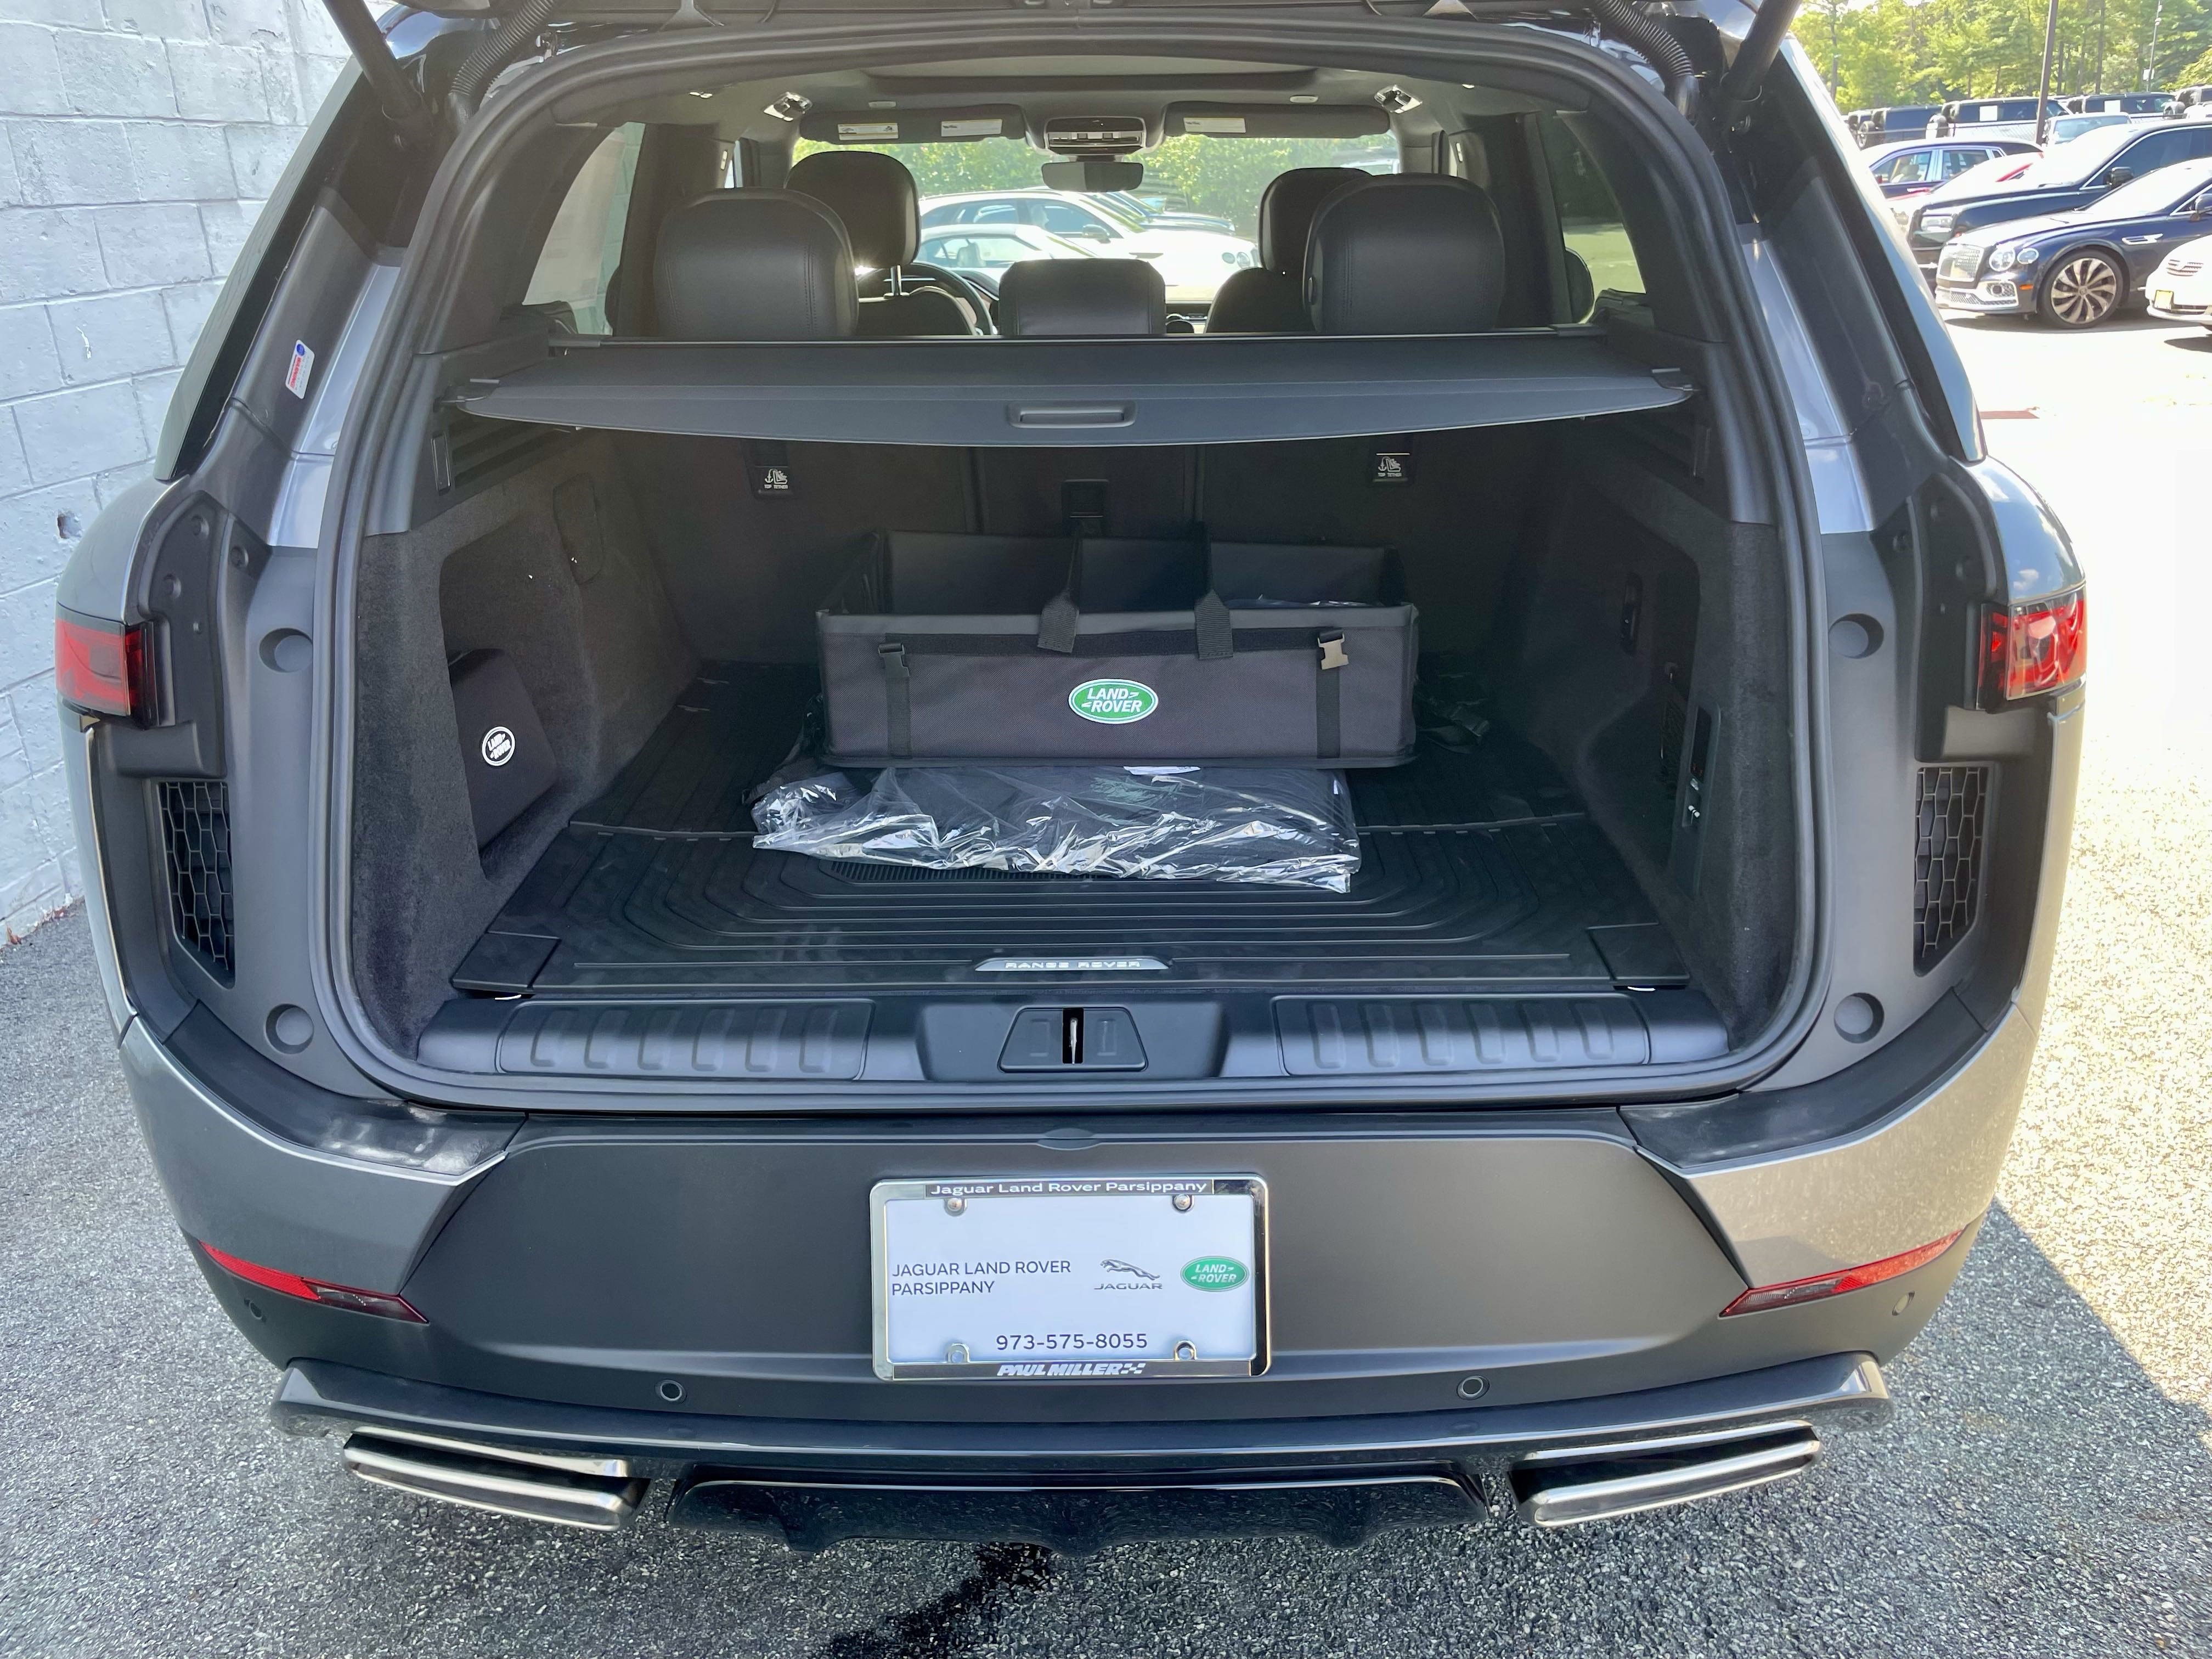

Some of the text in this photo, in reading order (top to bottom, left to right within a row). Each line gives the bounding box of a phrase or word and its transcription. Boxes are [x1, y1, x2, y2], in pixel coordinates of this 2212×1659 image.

[1087, 687, 1129, 700] LAND
[1091, 700, 1143, 713] ROVER
[930, 1180, 1207, 1195] Jaguar Land Rover Parsippany
[892, 1260, 1071, 1277] JAGUAR LAND ROVER
[1195, 1264, 1226, 1273] LAND
[1198, 1274, 1237, 1283] ROVER
[892, 1280, 995, 1296] PARSIPPANY
[996, 1333, 1148, 1350] 973-575-8055
[997, 1363, 1123, 1376] PAUL MILLER
